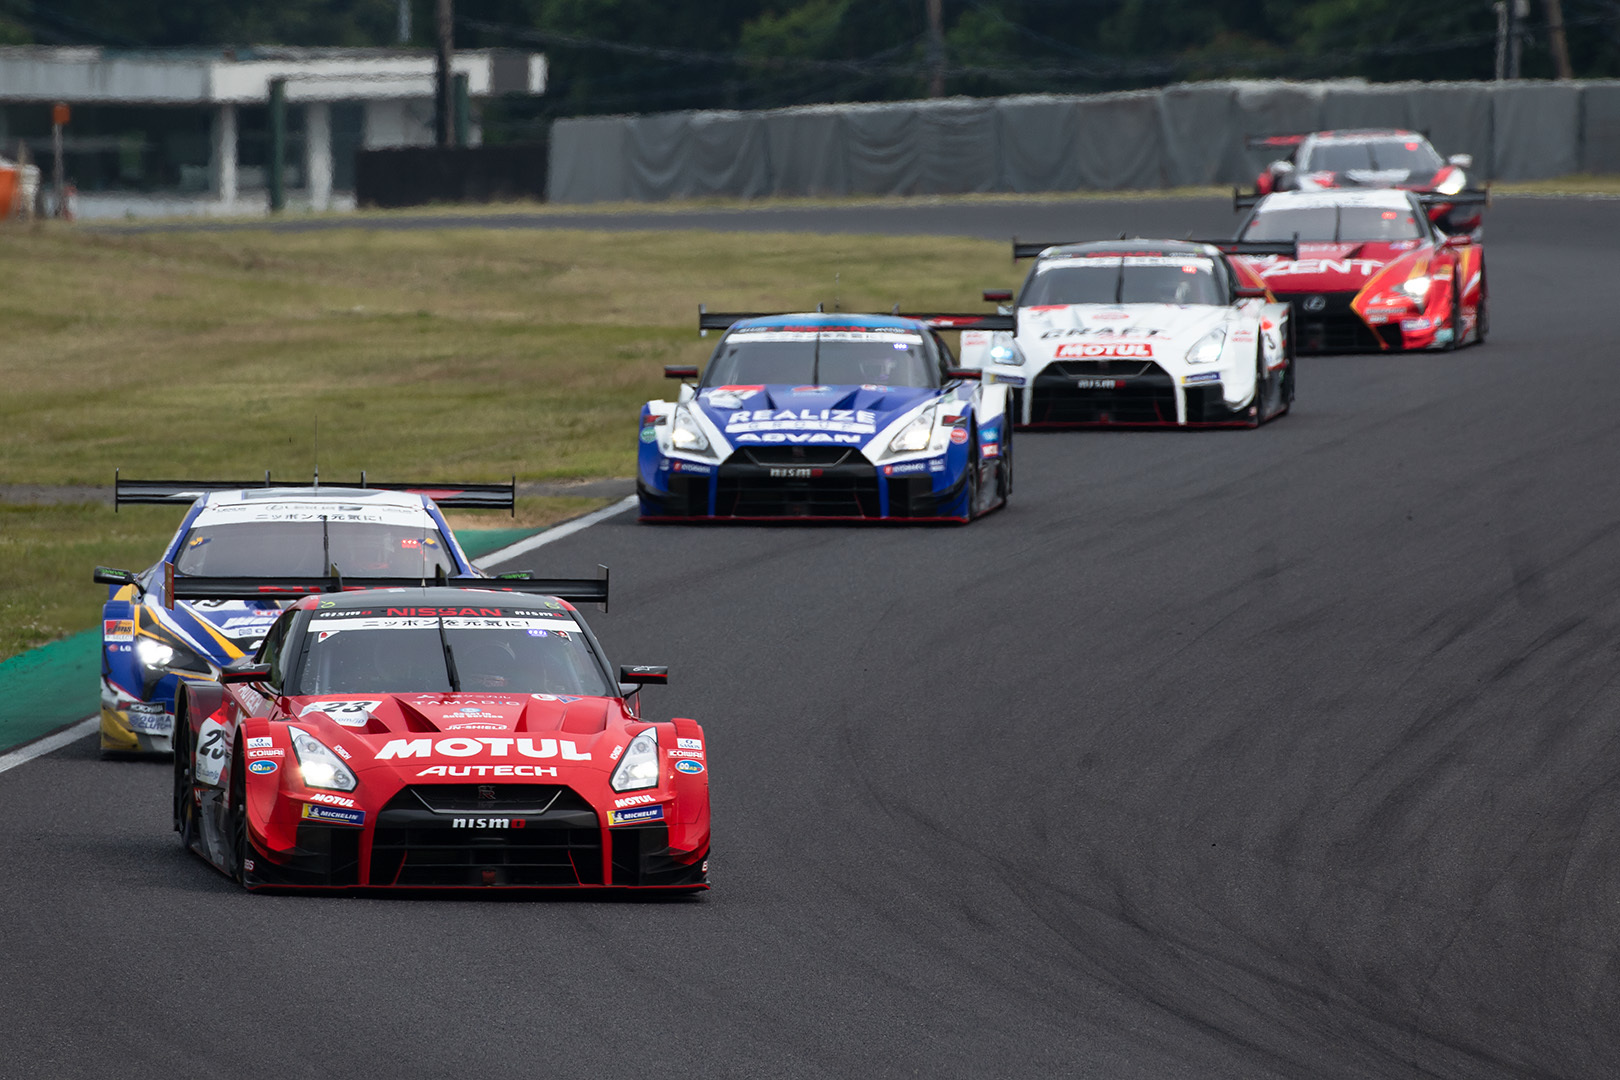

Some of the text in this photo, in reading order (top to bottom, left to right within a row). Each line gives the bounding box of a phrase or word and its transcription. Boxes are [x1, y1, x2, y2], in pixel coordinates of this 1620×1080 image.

[1260, 258, 1385, 277] ZENT
[1060, 344, 1150, 357] MOTUL
[728, 409, 876, 425] REALIZE
[735, 432, 861, 443] ADVAN
[320, 610, 372, 618] nismo
[386, 607, 502, 617] NISSAN
[514, 610, 564, 618] nismo
[322, 701, 373, 713] 23
[373, 737, 592, 761] MOTUL
[416, 765, 558, 777] AUTECH
[310, 793, 355, 807] MOTUL
[614, 794, 656, 808] MOTUL
[320, 810, 359, 820] MICHELIN
[623, 809, 658, 820] MICHELIN
[452, 818, 526, 829] nismo
